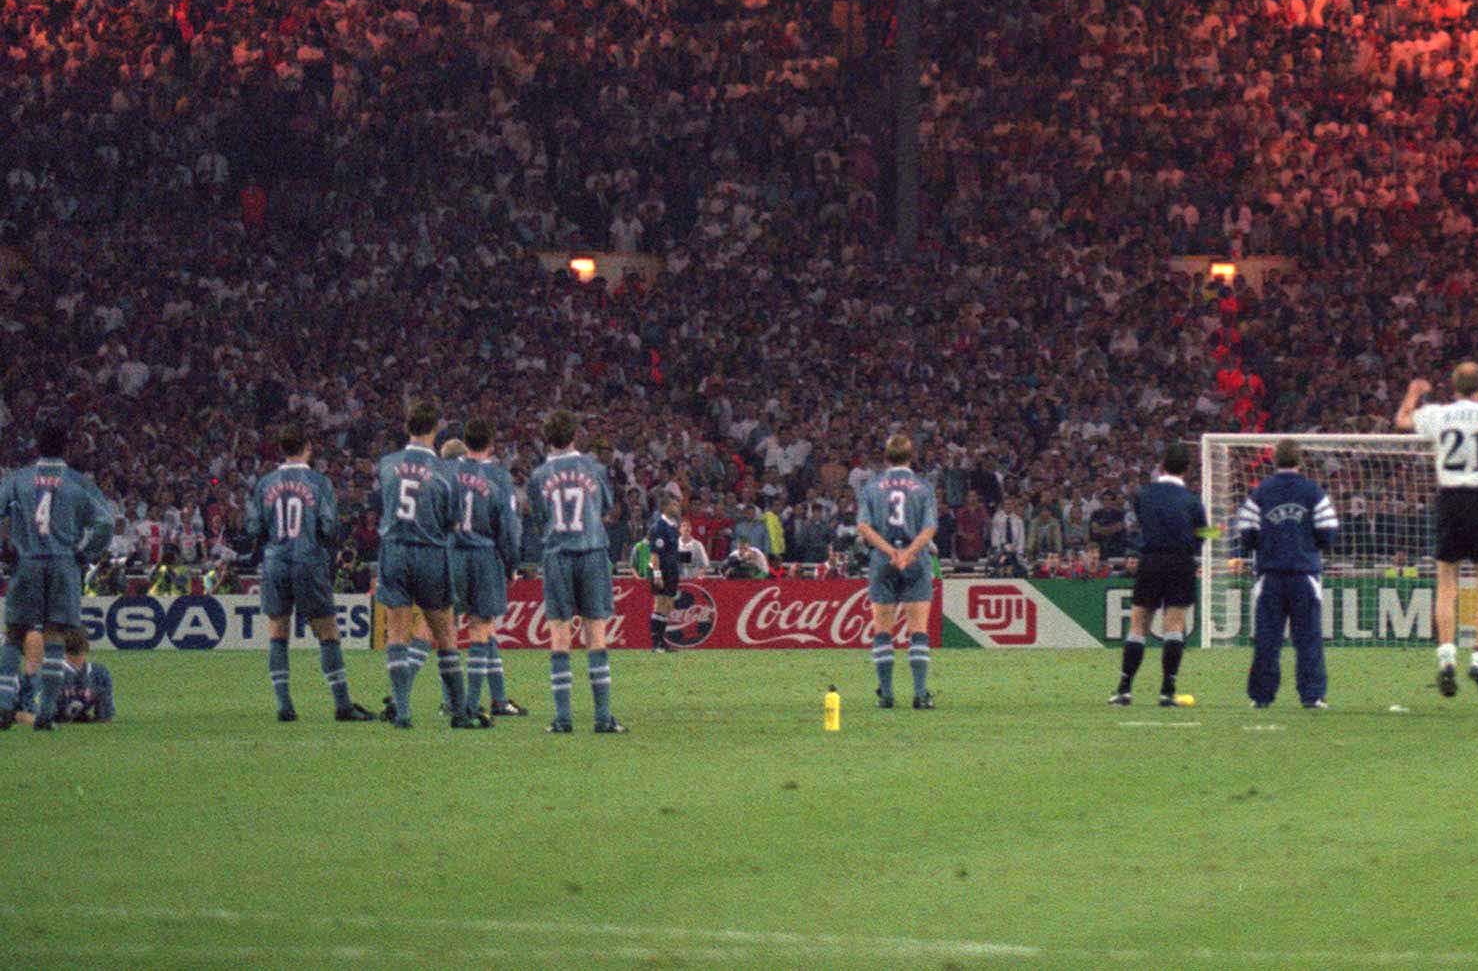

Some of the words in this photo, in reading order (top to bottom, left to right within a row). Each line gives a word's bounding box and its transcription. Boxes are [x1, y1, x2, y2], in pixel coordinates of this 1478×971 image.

[275, 497, 302, 541] 10
[397, 478, 420, 520] 5
[551, 487, 584, 532] 17
[887, 490, 906, 526] 3
